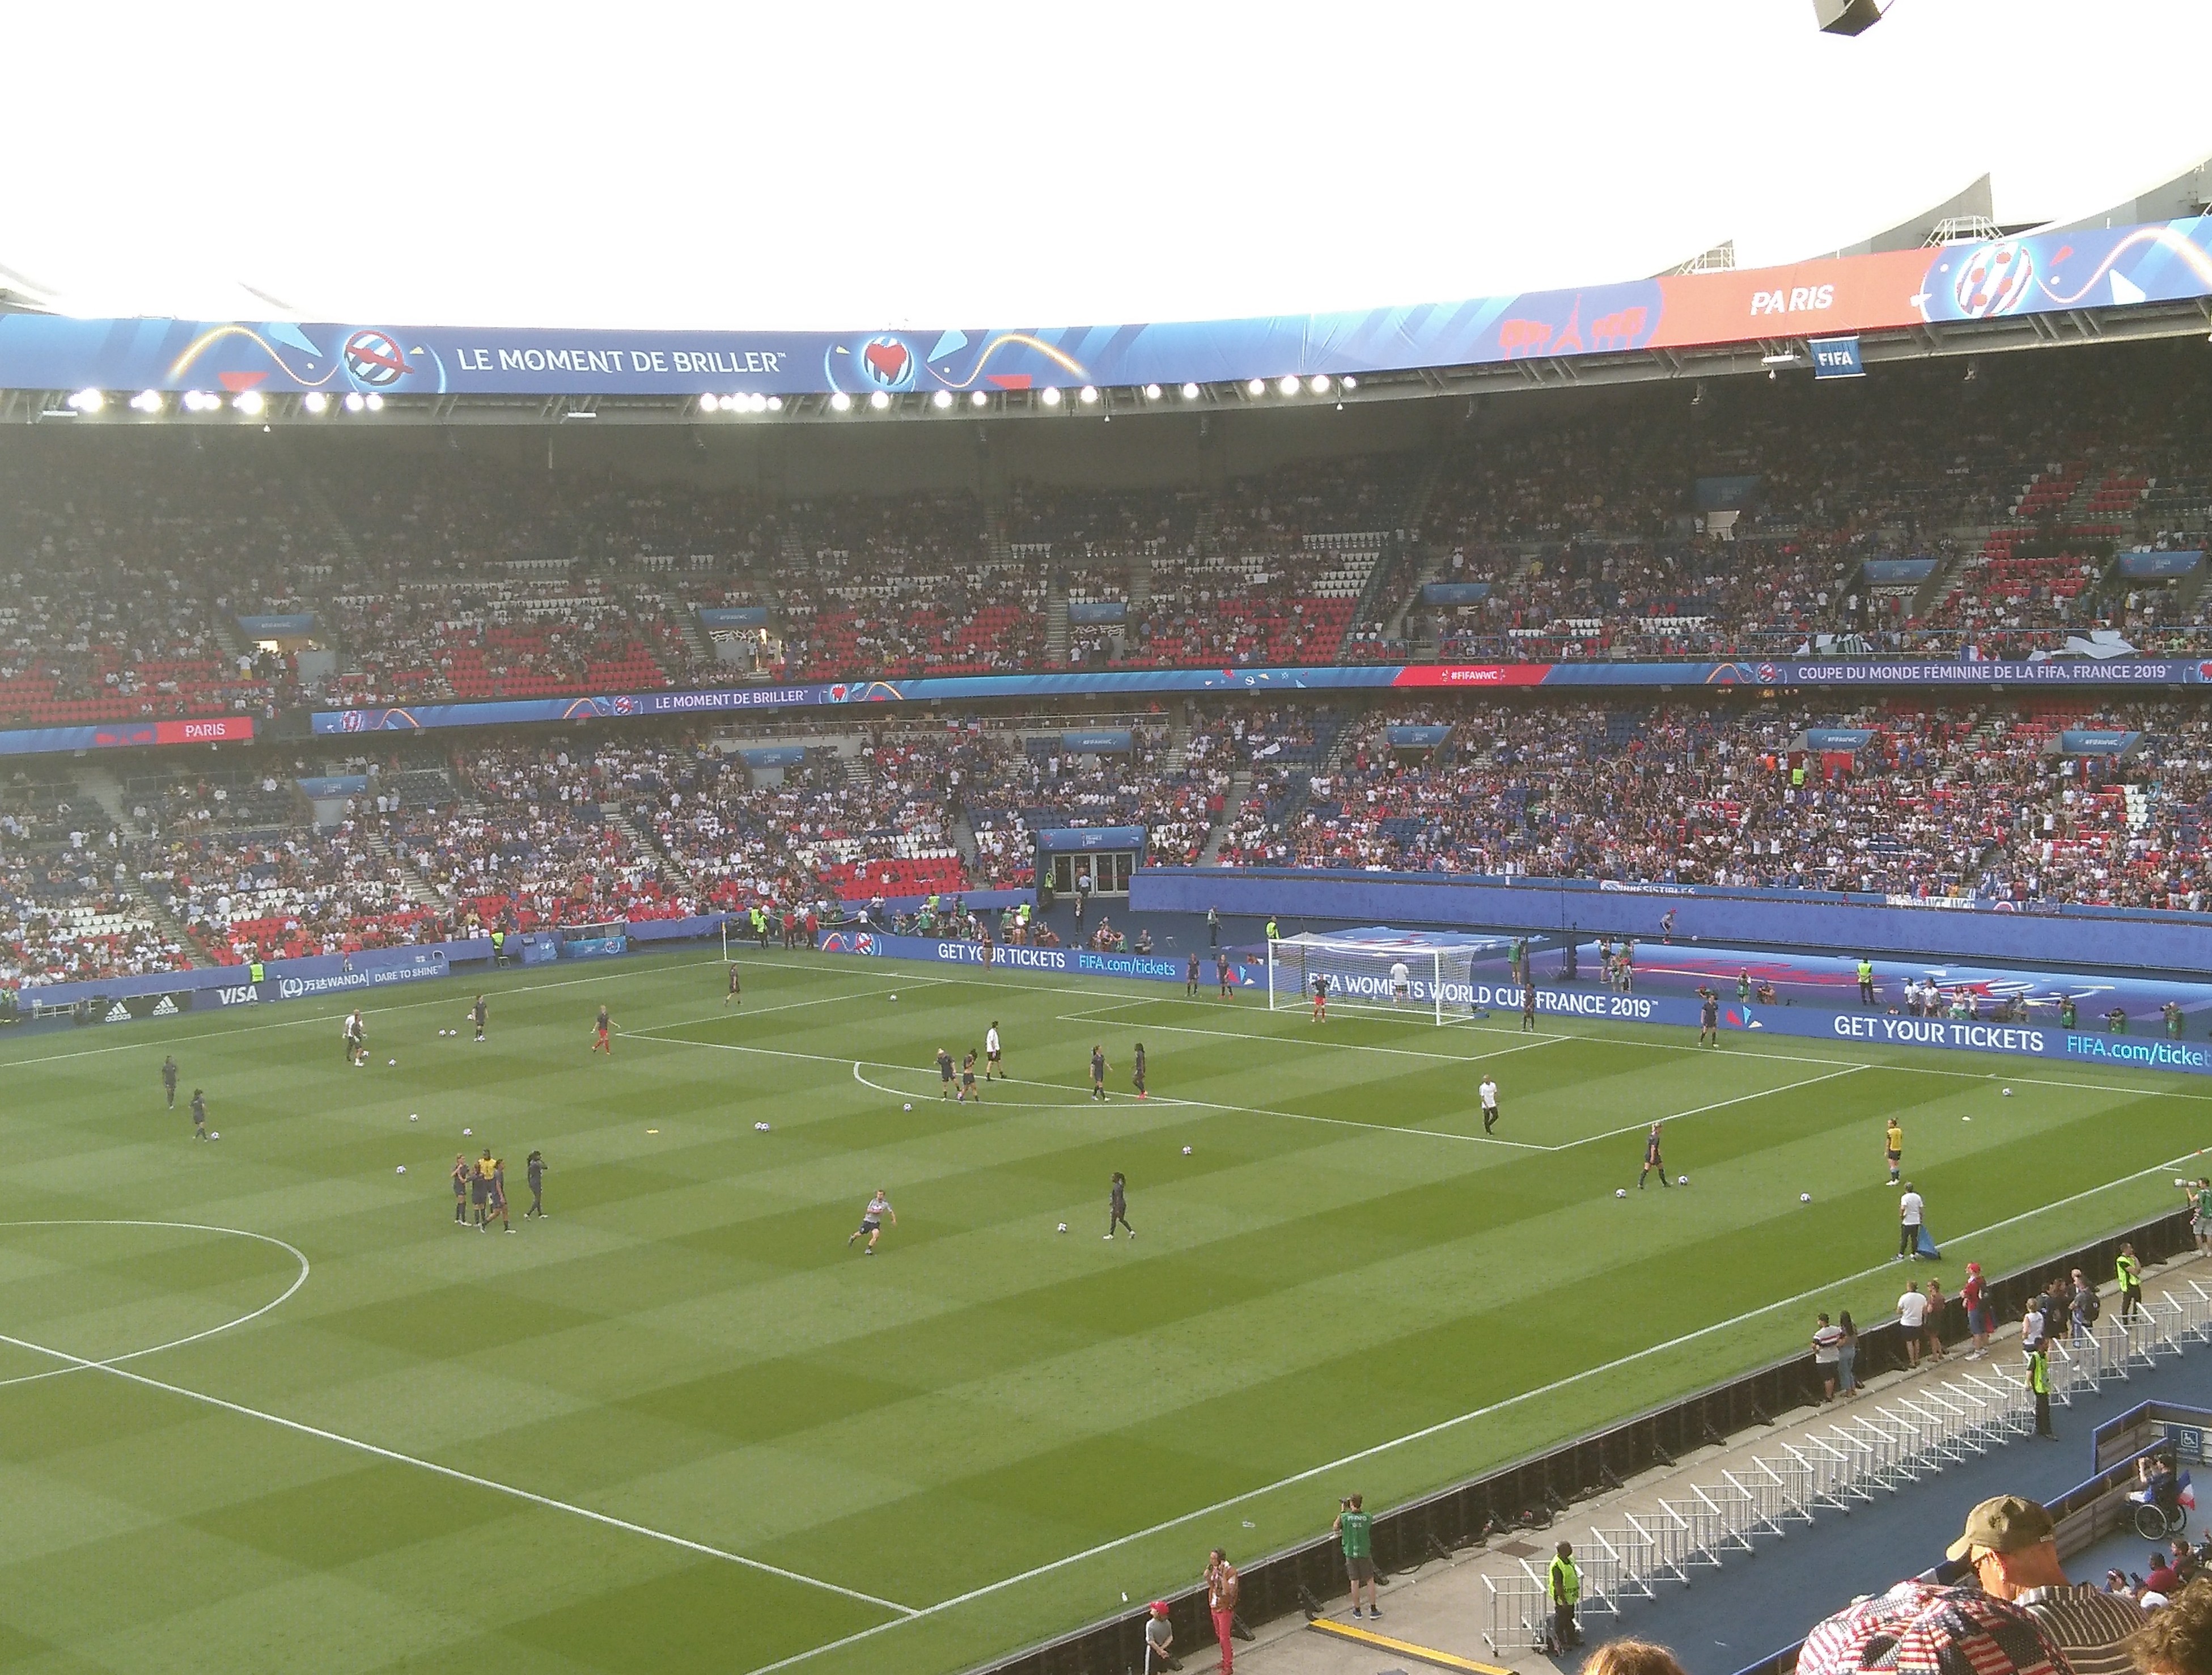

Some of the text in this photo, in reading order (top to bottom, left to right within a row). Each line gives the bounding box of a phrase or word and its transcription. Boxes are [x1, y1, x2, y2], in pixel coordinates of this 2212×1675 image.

[1750, 284, 1834, 316] PARIS
[457, 348, 493, 370] LE
[499, 349, 624, 374] MOMENT
[631, 350, 669, 372] DE
[1818, 351, 1853, 366] FIFA
[1451, 671, 1497, 680] #FIFAWWC
[1798, 667, 1842, 679] COUPE
[1846, 667, 1866, 679] DU
[1870, 666, 1920, 679] MONDE
[1924, 663, 1990, 679] FÉMININE
[1994, 666, 2012, 679] DE
[2016, 666, 2034, 679] LA
[2037, 665, 2070, 679] FIFA,
[2073, 665, 2130, 679] FRANCE
[656, 697, 671, 709] LE
[673, 693, 731, 708] MOMENT
[733, 692, 751, 704] DE
[185, 723, 226, 737] PARIS
[938, 943, 965, 959] GET
[1008, 949, 1065, 968] TICKETS
[1079, 954, 1176, 976] FIFA.com/tickets
[375, 971, 398, 983] DARE
[400, 969, 412, 979] TO
[216, 985, 259, 1005] VISA
[1429, 981, 1491, 1003] WORLD
[1535, 991, 1606, 1014] FRANCE
[105, 1013, 132, 1022] adidas
[153, 1006, 179, 1016] adidas
[1834, 1016, 2044, 1051] GET YOUR TICKETS
